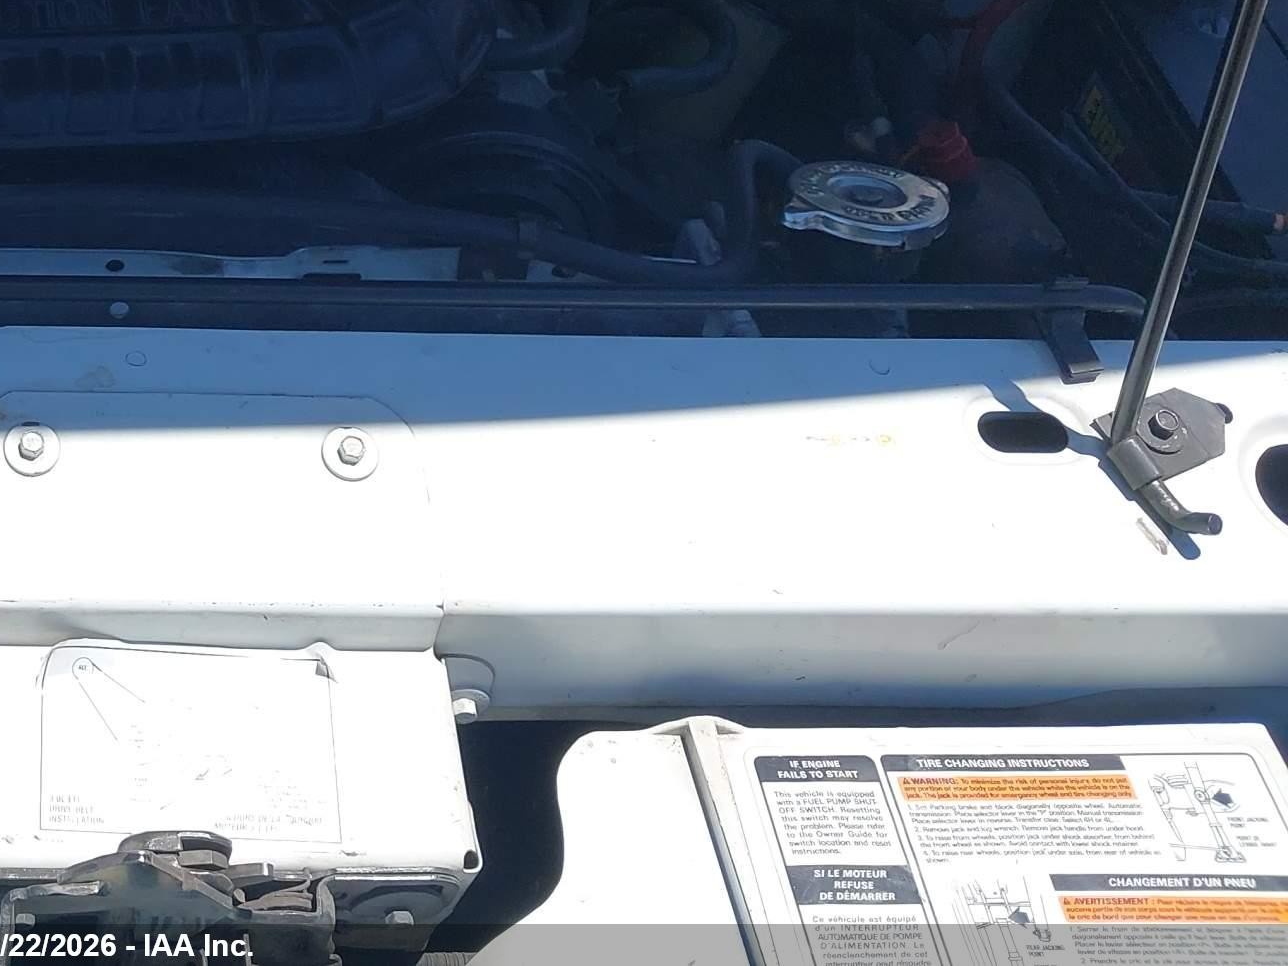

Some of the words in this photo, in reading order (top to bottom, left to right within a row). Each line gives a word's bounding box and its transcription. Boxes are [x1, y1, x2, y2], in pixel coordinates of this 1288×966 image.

[789, 760, 800, 768] IF
[803, 760, 841, 768] ENGINE
[916, 759, 943, 768] TIRE
[944, 759, 1006, 768] CHANGING
[1008, 759, 1090, 768] INSTRUCTIONS
[777, 770, 808, 779] FAILS
[809, 770, 825, 779] TO
[826, 770, 859, 779] START
[814, 869, 825, 878] SI
[827, 869, 840, 878] LE
[843, 869, 887, 878] MOTEUR
[834, 881, 874, 889] REFUSE
[1109, 877, 1191, 887] CHANGEMENT
[1193, 878, 1222, 888] D'UN
[1224, 878, 1257, 888] PNEU
[820, 892, 834, 901] DE
[836, 890, 896, 901] DÉMARRER
